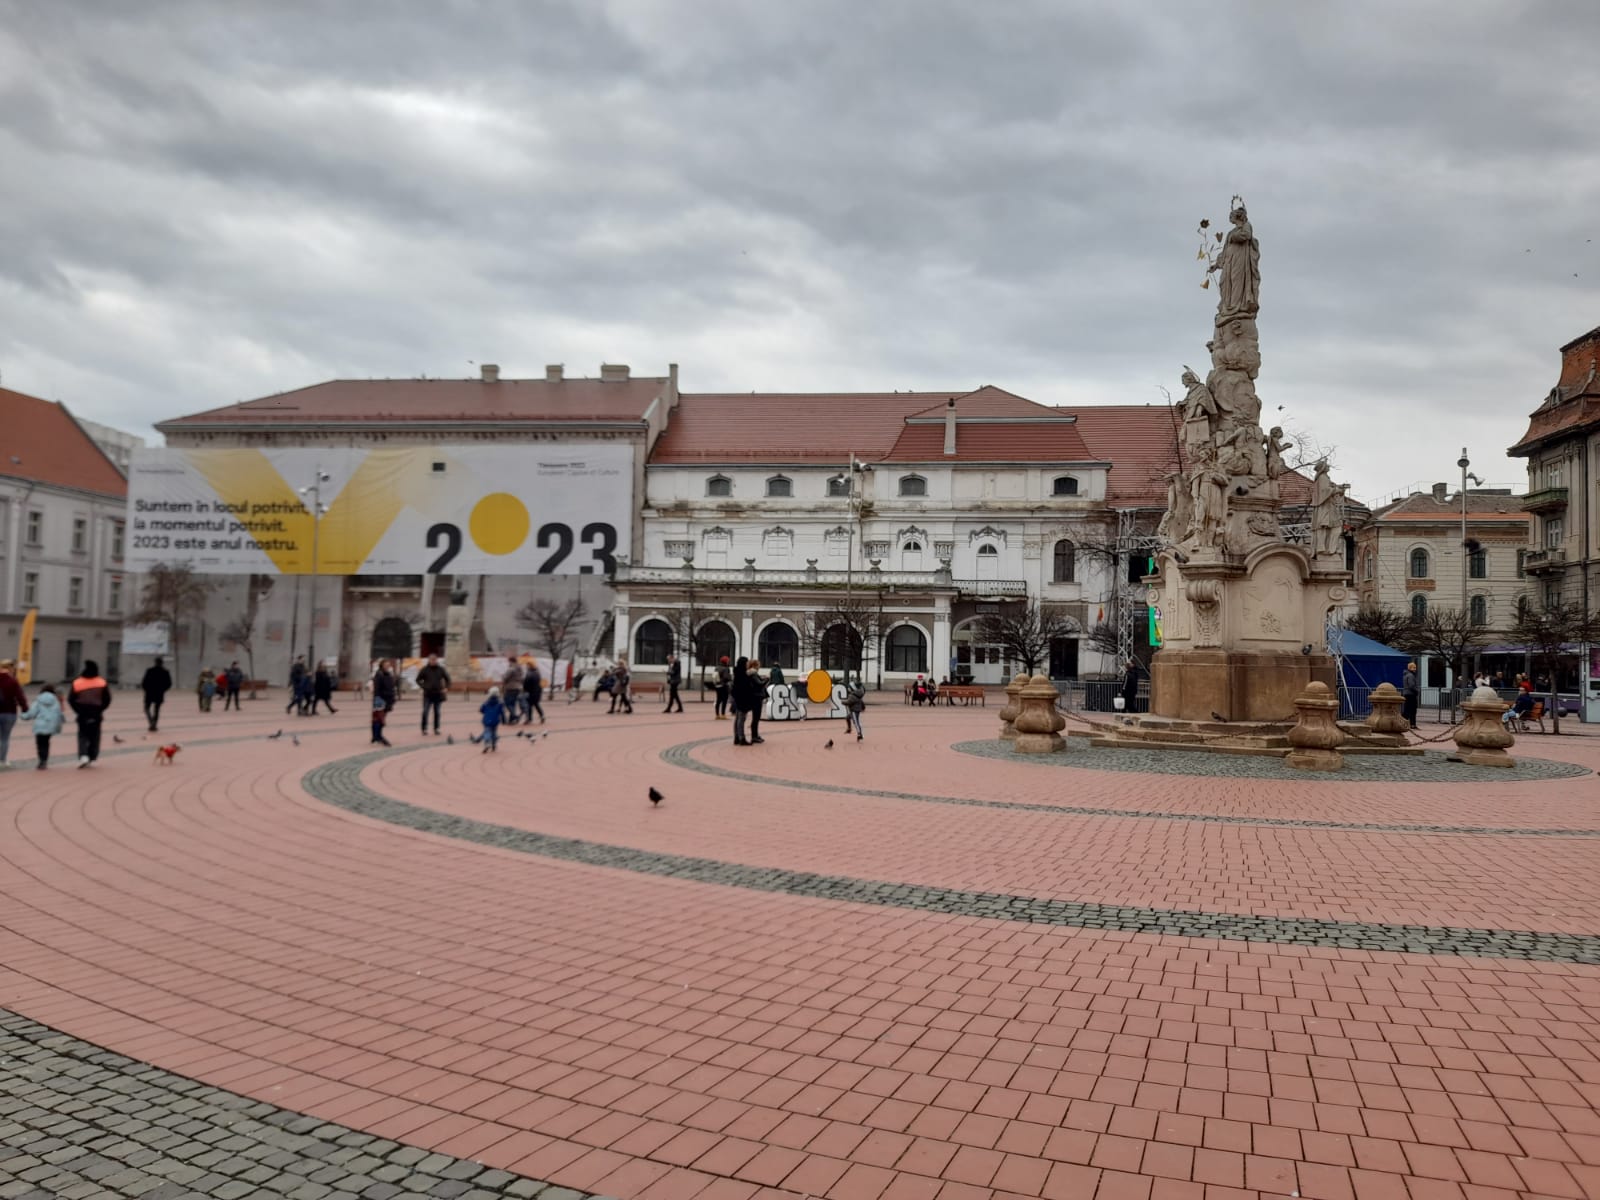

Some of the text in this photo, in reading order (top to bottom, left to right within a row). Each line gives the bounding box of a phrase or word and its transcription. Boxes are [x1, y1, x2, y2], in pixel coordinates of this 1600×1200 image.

[135, 500, 192, 513] Suntem
[213, 501, 248, 513] locul
[133, 517, 145, 530] la
[150, 518, 225, 531] momentul
[133, 535, 298, 550] 2023 este anul nostru.
